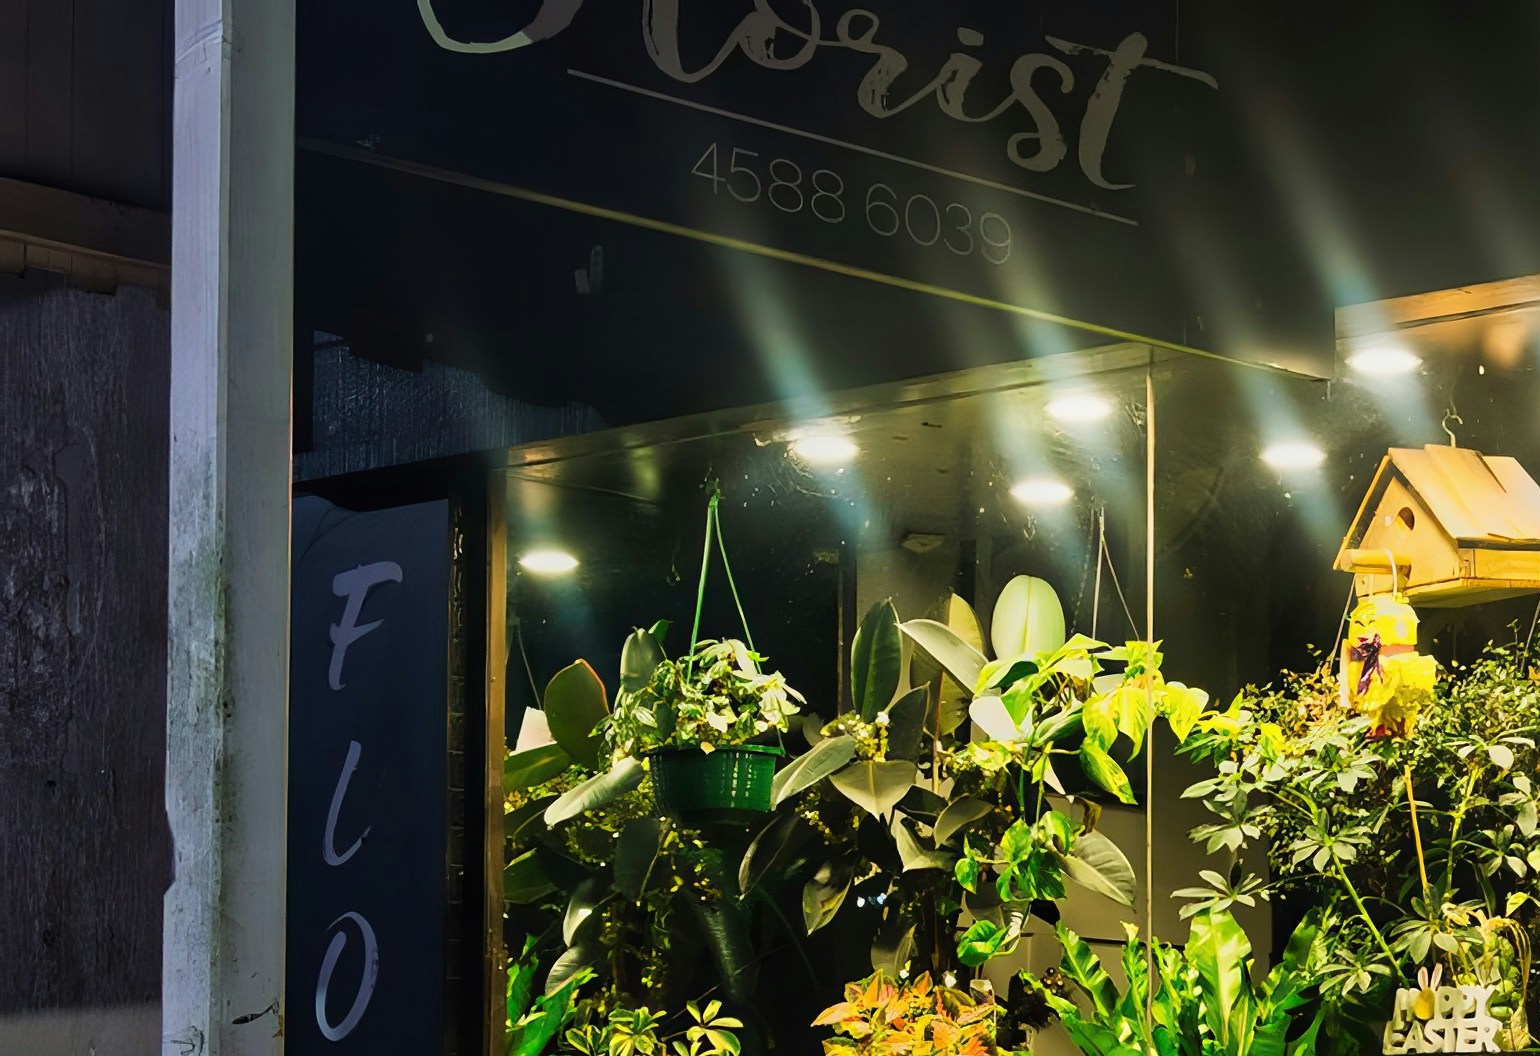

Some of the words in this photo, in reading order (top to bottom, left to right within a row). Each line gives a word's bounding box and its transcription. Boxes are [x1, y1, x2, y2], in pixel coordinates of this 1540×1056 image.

[690, 142, 846, 224] 4588
[864, 181, 1013, 265] 6039
[1391, 984, 1500, 1031] HPPY
[1383, 1016, 1503, 1056] EASTER
